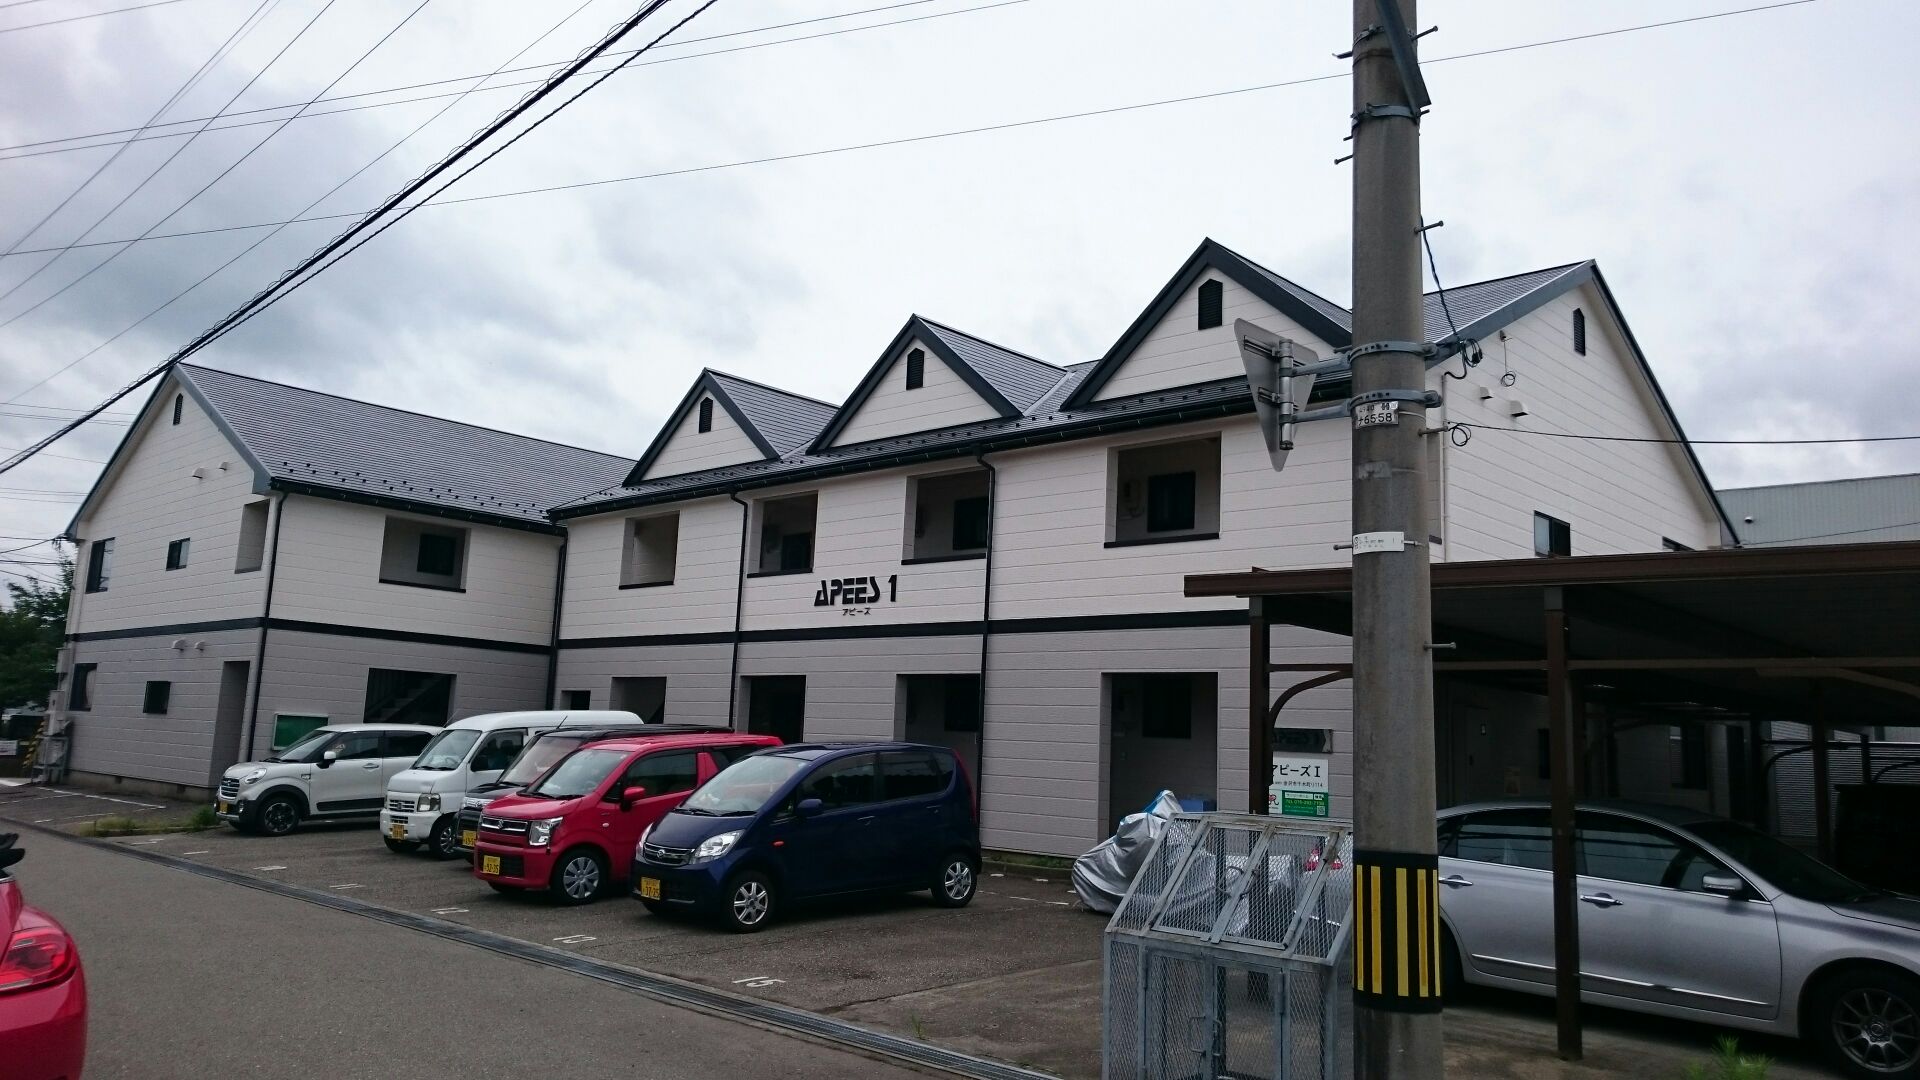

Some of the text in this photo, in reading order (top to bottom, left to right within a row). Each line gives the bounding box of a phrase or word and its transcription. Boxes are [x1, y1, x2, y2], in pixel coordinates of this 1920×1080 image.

[814, 574, 898, 606] APEES 1
[731, 976, 786, 988] 15
